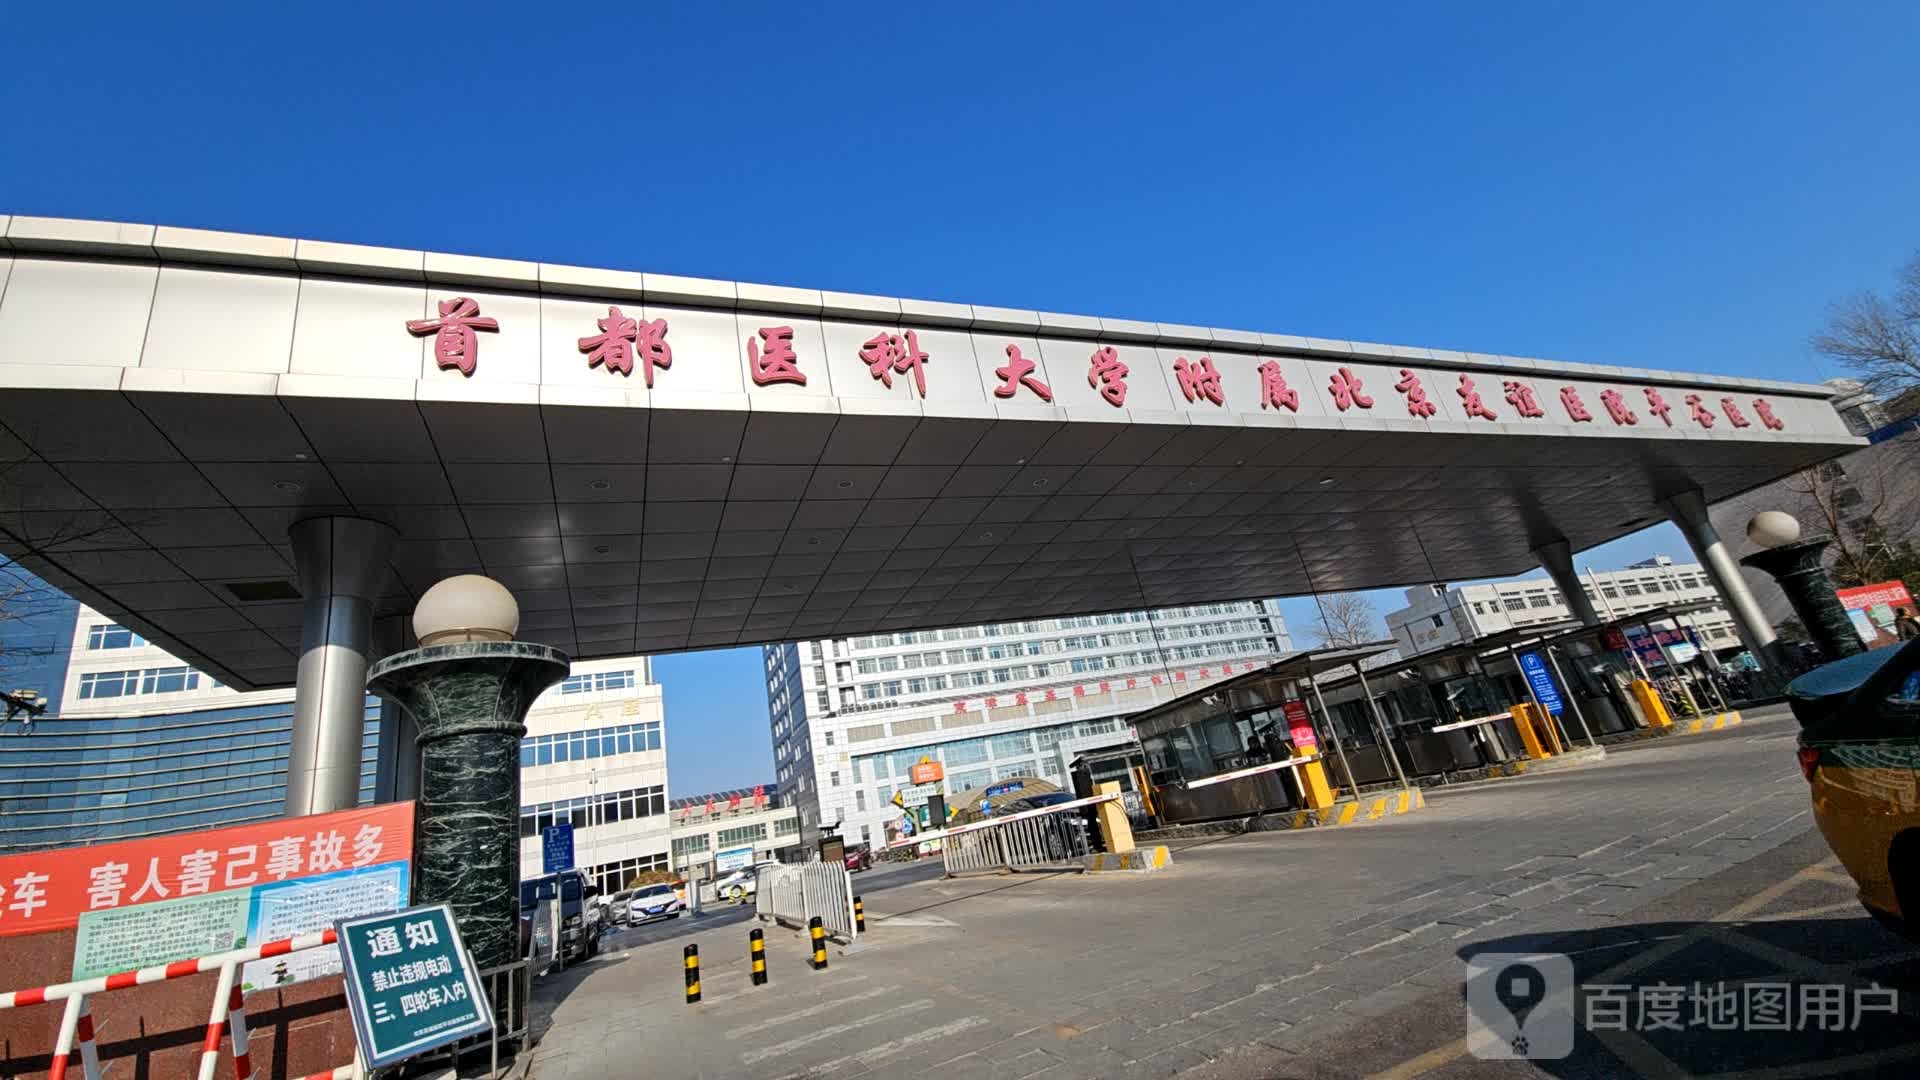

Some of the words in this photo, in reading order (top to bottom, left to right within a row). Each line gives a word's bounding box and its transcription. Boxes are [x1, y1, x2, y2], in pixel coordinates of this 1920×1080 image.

[548, 828, 560, 844] P
[0, 871, 50, 918] 车
[87, 823, 385, 910] 害人害己事故多
[365, 919, 440, 959] 通知
[371, 955, 453, 992] 禁止违规电动
